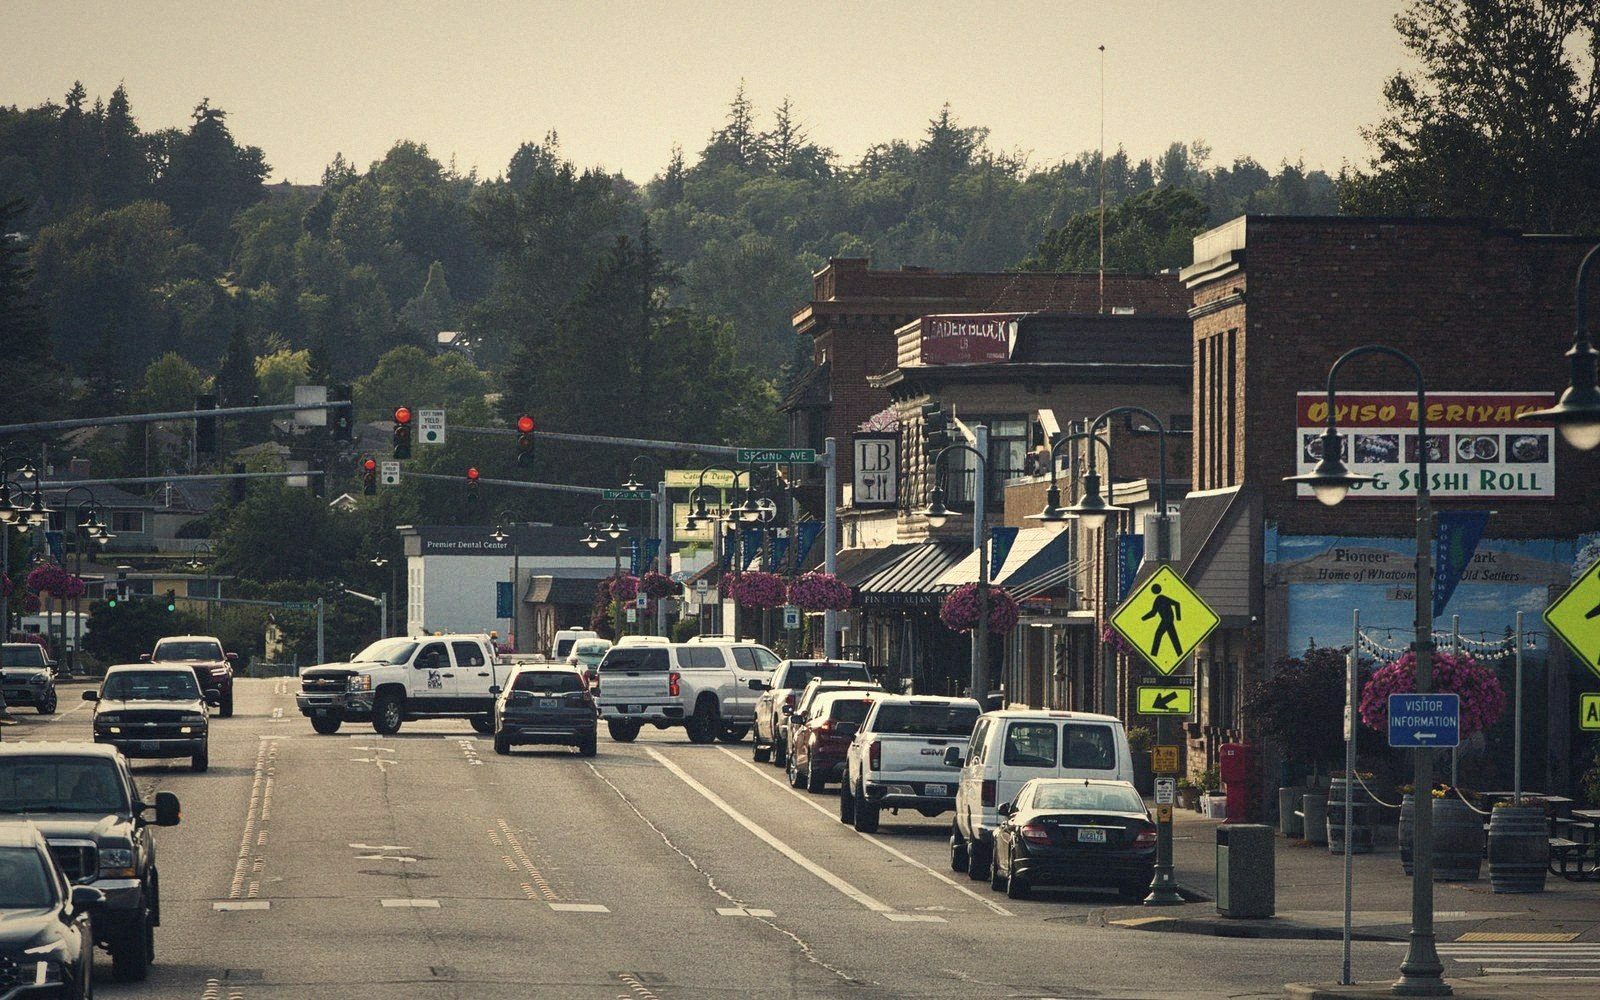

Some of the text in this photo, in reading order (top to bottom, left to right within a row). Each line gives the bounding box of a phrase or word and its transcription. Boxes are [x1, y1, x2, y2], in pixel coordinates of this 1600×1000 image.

[922, 319, 1006, 342] EADER BLOCK
[1406, 402, 1545, 422] TERIYAK
[860, 443, 891, 471] LB
[1480, 469, 1542, 491] ROLL
[427, 541, 456, 549] Premier
[458, 541, 482, 549] Dental
[1334, 549, 1497, 563] Pioneer ark
[1318, 568, 1350, 580] Home
[1353, 567, 1366, 582] of
[1368, 568, 1416, 580] Whatcom
[1481, 570, 1520, 581] Settlers
[1391, 700, 1457, 728] VISITOR INFORMATION
[920, 748, 945, 756] GM
